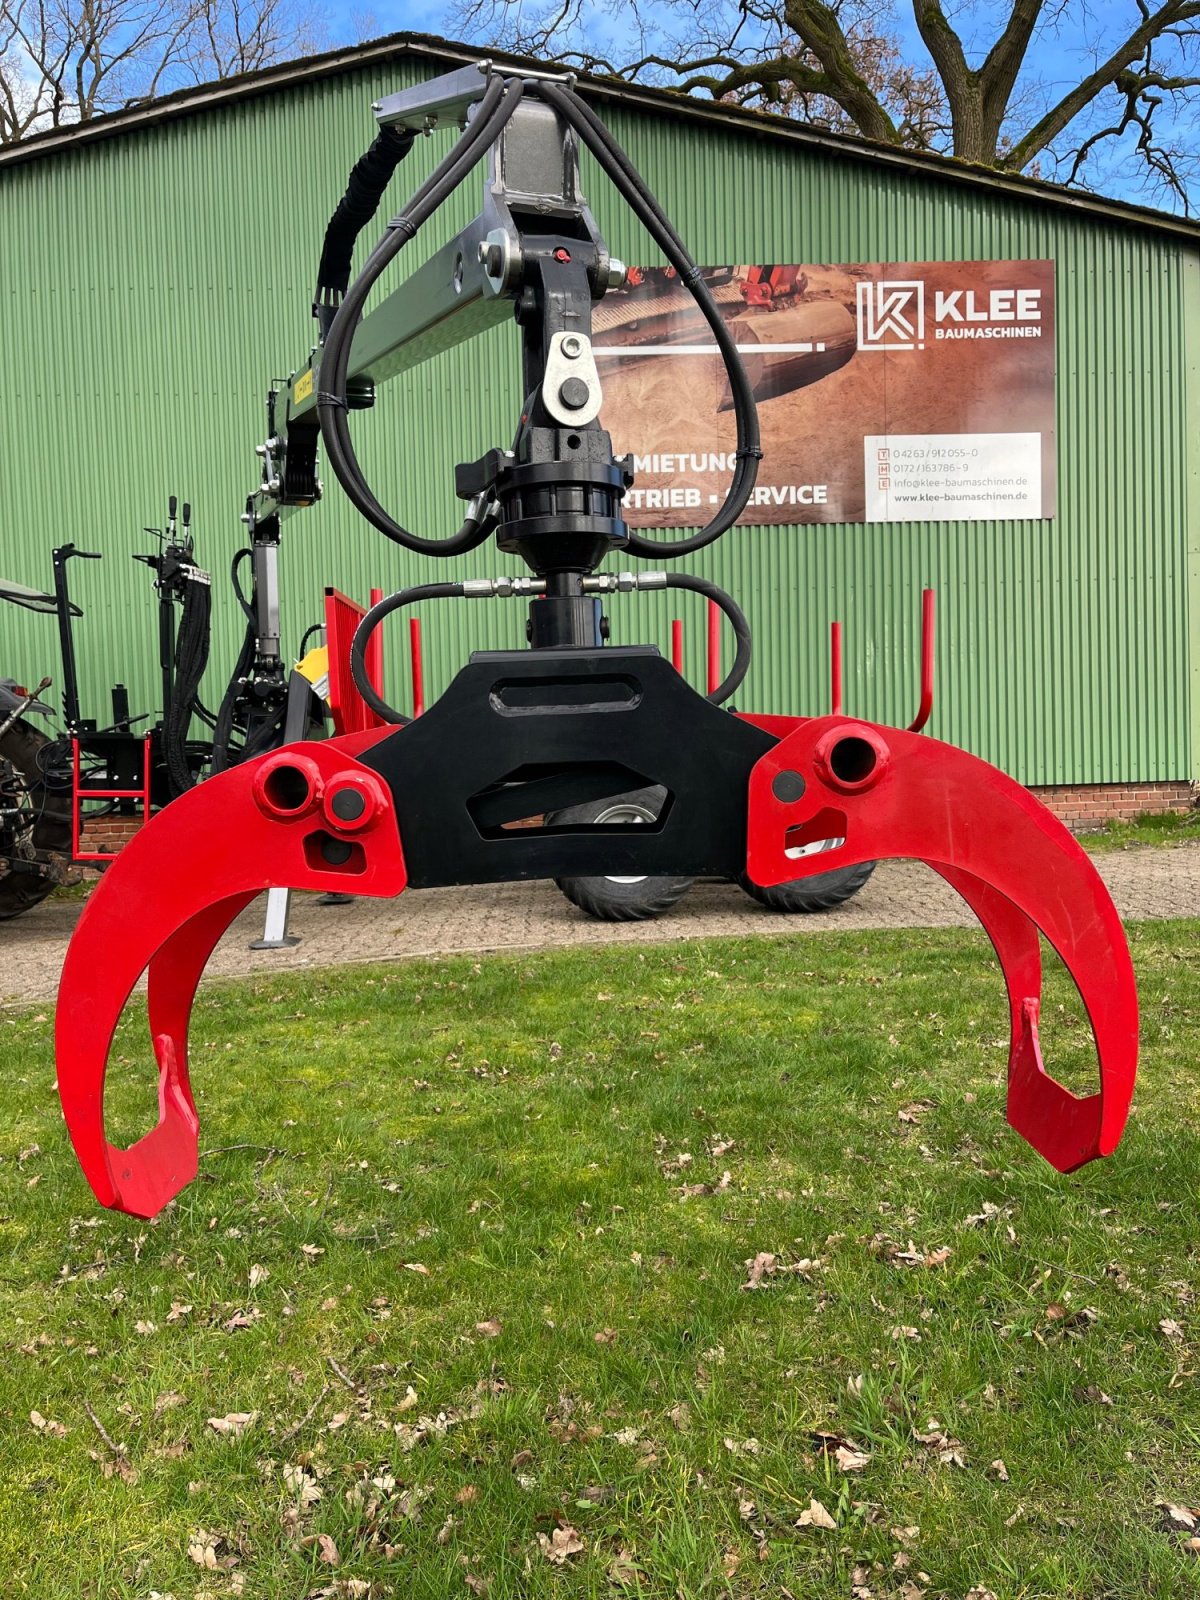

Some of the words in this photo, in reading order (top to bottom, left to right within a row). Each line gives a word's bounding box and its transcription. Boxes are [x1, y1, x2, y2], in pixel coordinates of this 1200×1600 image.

[935, 289, 1042, 322] KLEE
[935, 326, 1042, 340] BAUMASCHINEN
[894, 478, 1028, 488] info@klee-baumaschinen.de
[894, 492, 1028, 502] www.klee-baumaschinen.de
